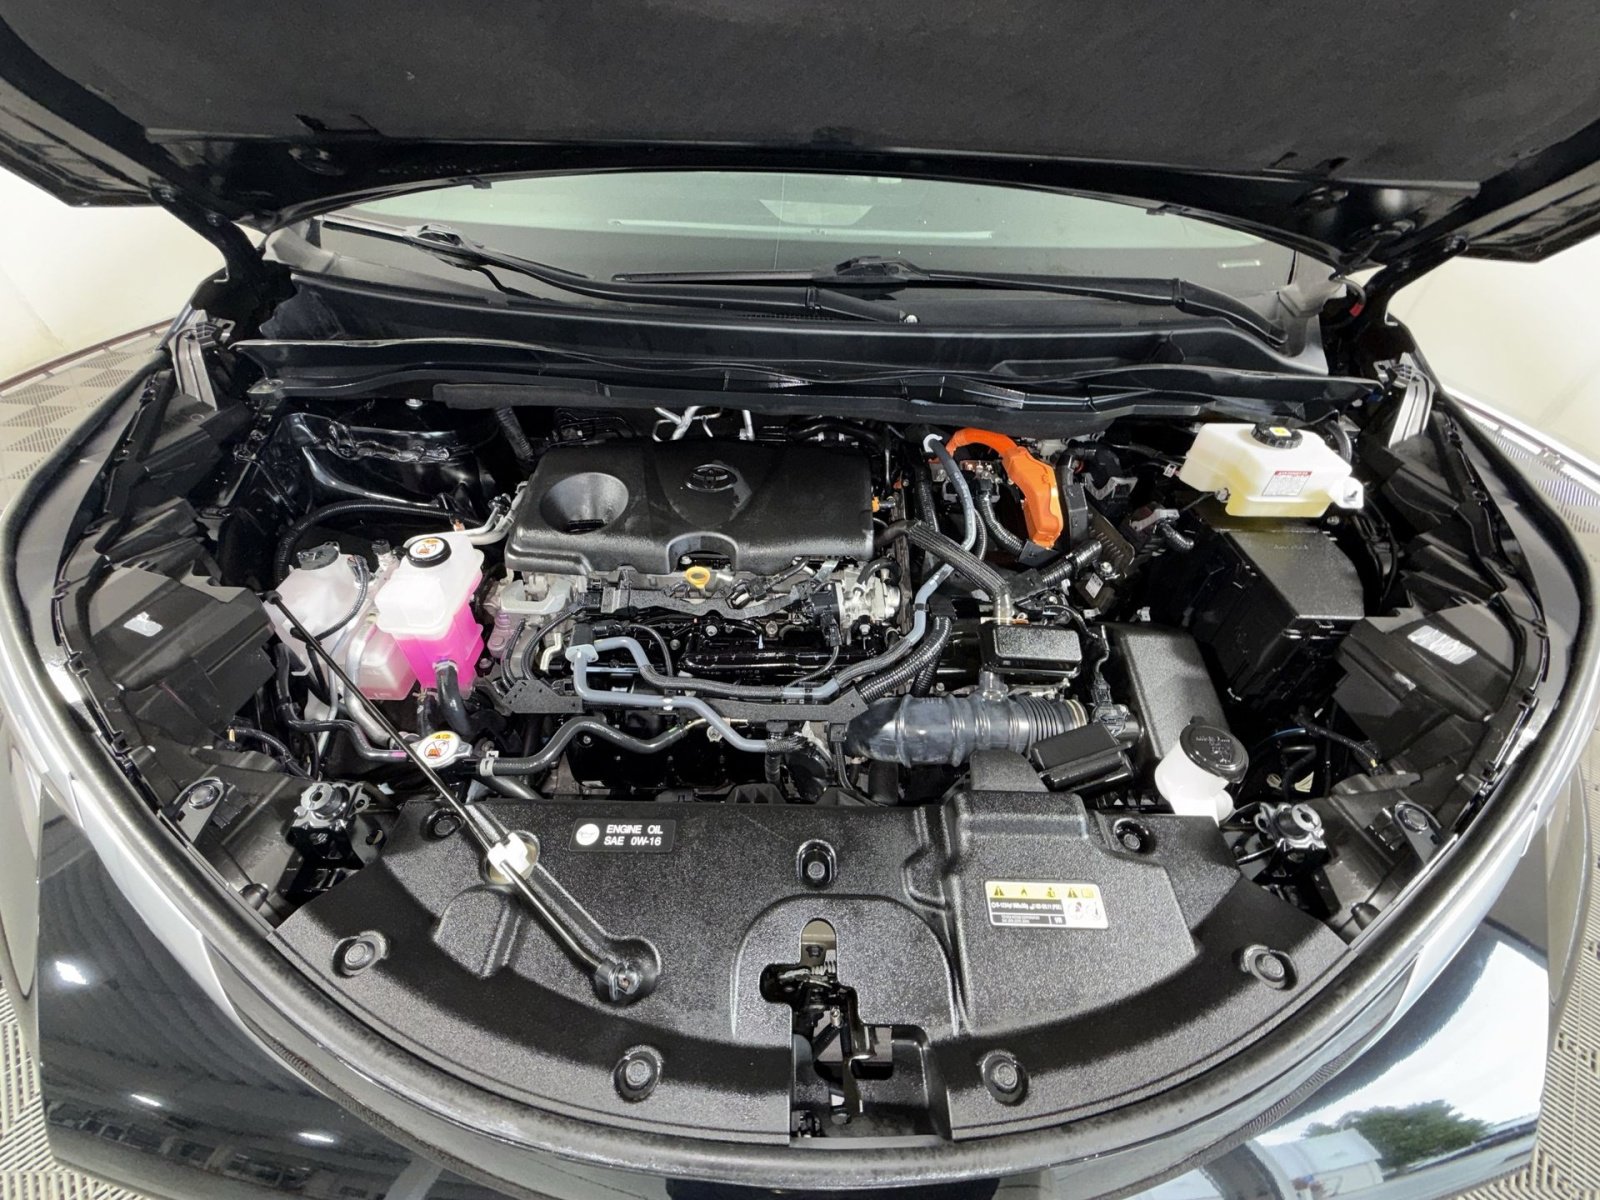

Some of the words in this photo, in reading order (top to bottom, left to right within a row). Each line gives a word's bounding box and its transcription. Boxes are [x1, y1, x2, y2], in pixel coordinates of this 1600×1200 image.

[606, 824, 643, 834] ENGINE
[647, 824, 664, 834] OIL
[603, 836, 625, 846] SAE
[630, 836, 662, 846] 0W-16
